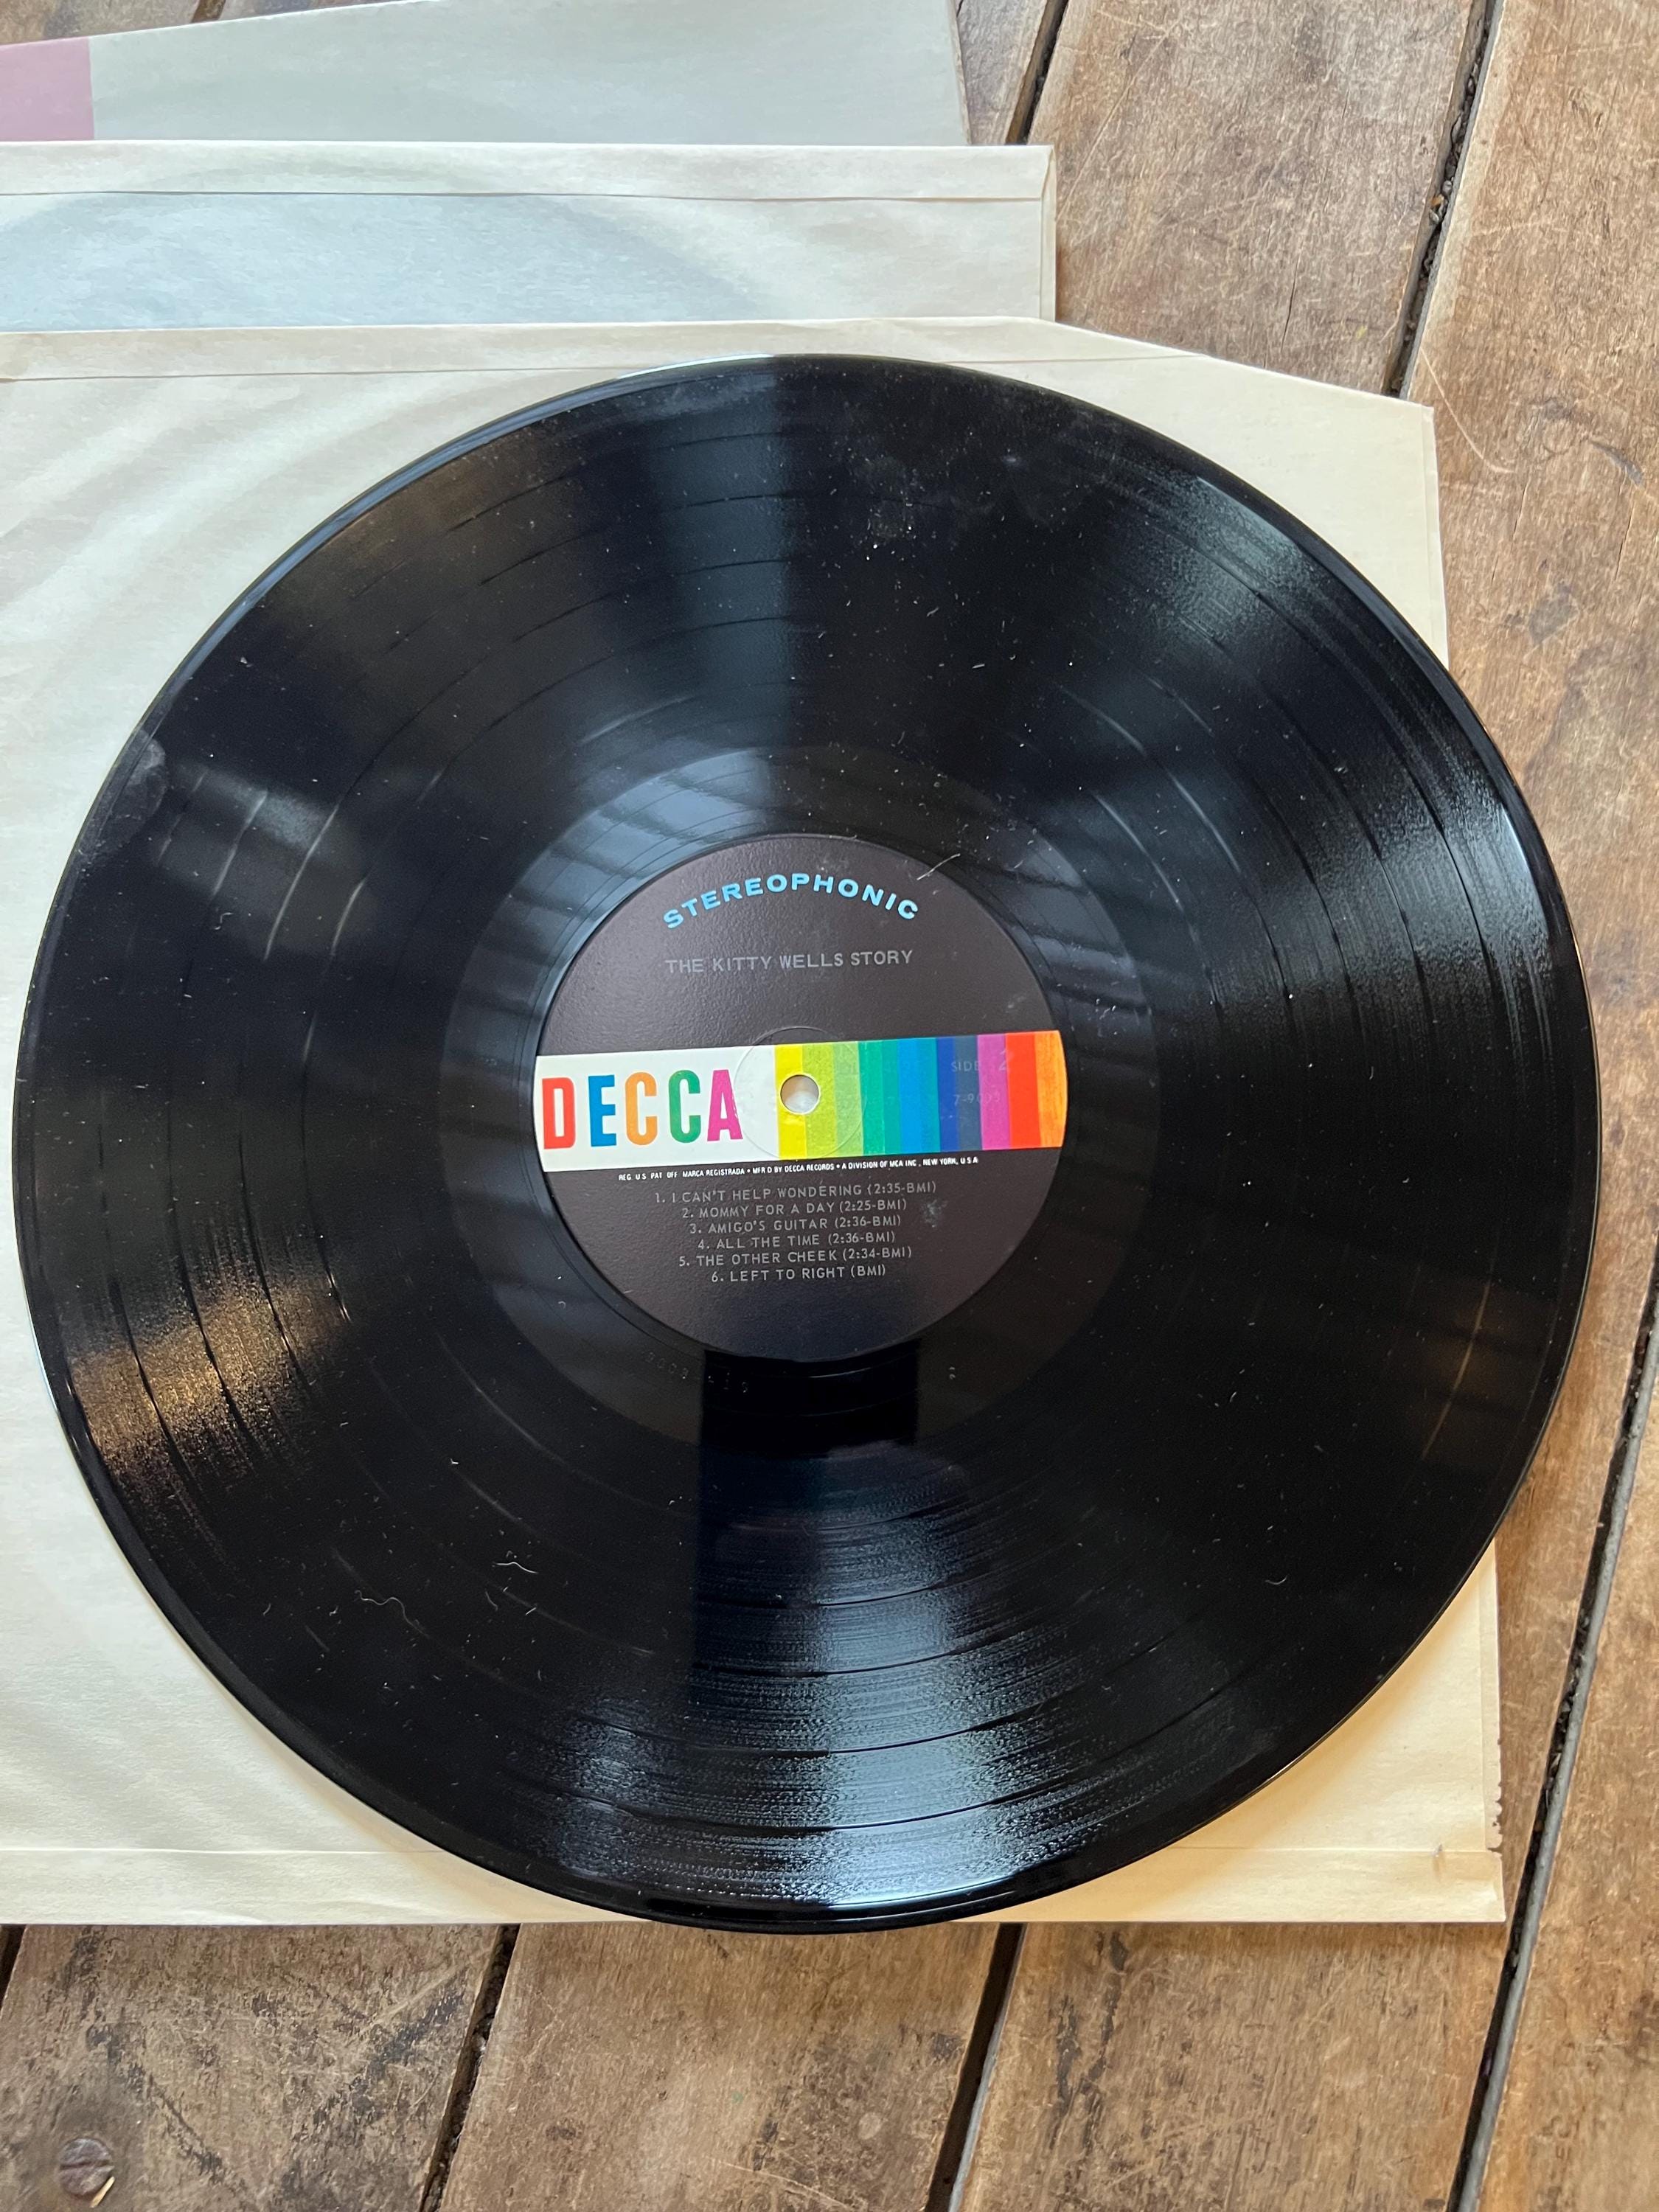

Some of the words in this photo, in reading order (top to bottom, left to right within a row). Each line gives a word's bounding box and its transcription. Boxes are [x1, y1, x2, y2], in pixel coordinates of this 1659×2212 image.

[663, 873, 918, 928] STEREOPHONIC
[665, 959, 704, 973] THE
[712, 956, 771, 972] KITTY
[779, 953, 844, 969] WELLS
[850, 950, 913, 966] STORY
[950, 1060, 980, 1072] SIDE
[542, 1069, 743, 1150] DECCA
[682, 1169, 704, 1178] MARCA
[706, 1168, 745, 1177] REGISTRADA
[785, 1164, 804, 1172] DECCA
[848, 1161, 877, 1169] DIVISION
[923, 1158, 937, 1166] NEW
[655, 1192, 665, 1203] 1.
[672, 1192, 675, 1203] I
[682, 1190, 726, 1202] CAN'T
[732, 1189, 771, 1200] HELP
[777, 1184, 862, 1198] WONDERING
[867, 1182, 936, 1196] (2:35-BMI)
[682, 1208, 693, 1218] 2.
[700, 1206, 749, 1218] MOMMY
[756, 1204, 784, 1216] FOR
[790, 1203, 799, 1214] A
[806, 1202, 835, 1214] DAY
[839, 1199, 907, 1214] (2:25-BMI)
[689, 1223, 701, 1234] 3.
[708, 1220, 765, 1234] AMIGO'S
[774, 1218, 827, 1231] GUITAR
[835, 1215, 901, 1229] (2:36-BMI)
[698, 1239, 710, 1250] 4.
[716, 1238, 745, 1249] ALL
[751, 1237, 780, 1248] THE
[787, 1234, 820, 1246] TIME
[828, 1231, 895, 1246] (2:36-BMI)
[679, 1256, 689, 1267] 5.
[696, 1254, 724, 1267] THE
[731, 1253, 780, 1265] OTHER
[787, 1250, 837, 1262] CHEEK
[843, 1246, 911, 1262] (2:34-BMI)
[712, 1271, 724, 1282] 6.
[730, 1270, 769, 1282] LEFT
[776, 1269, 795, 1280] TO
[801, 1266, 845, 1279] RIGHT
[850, 1264, 886, 1278] (BMI)
